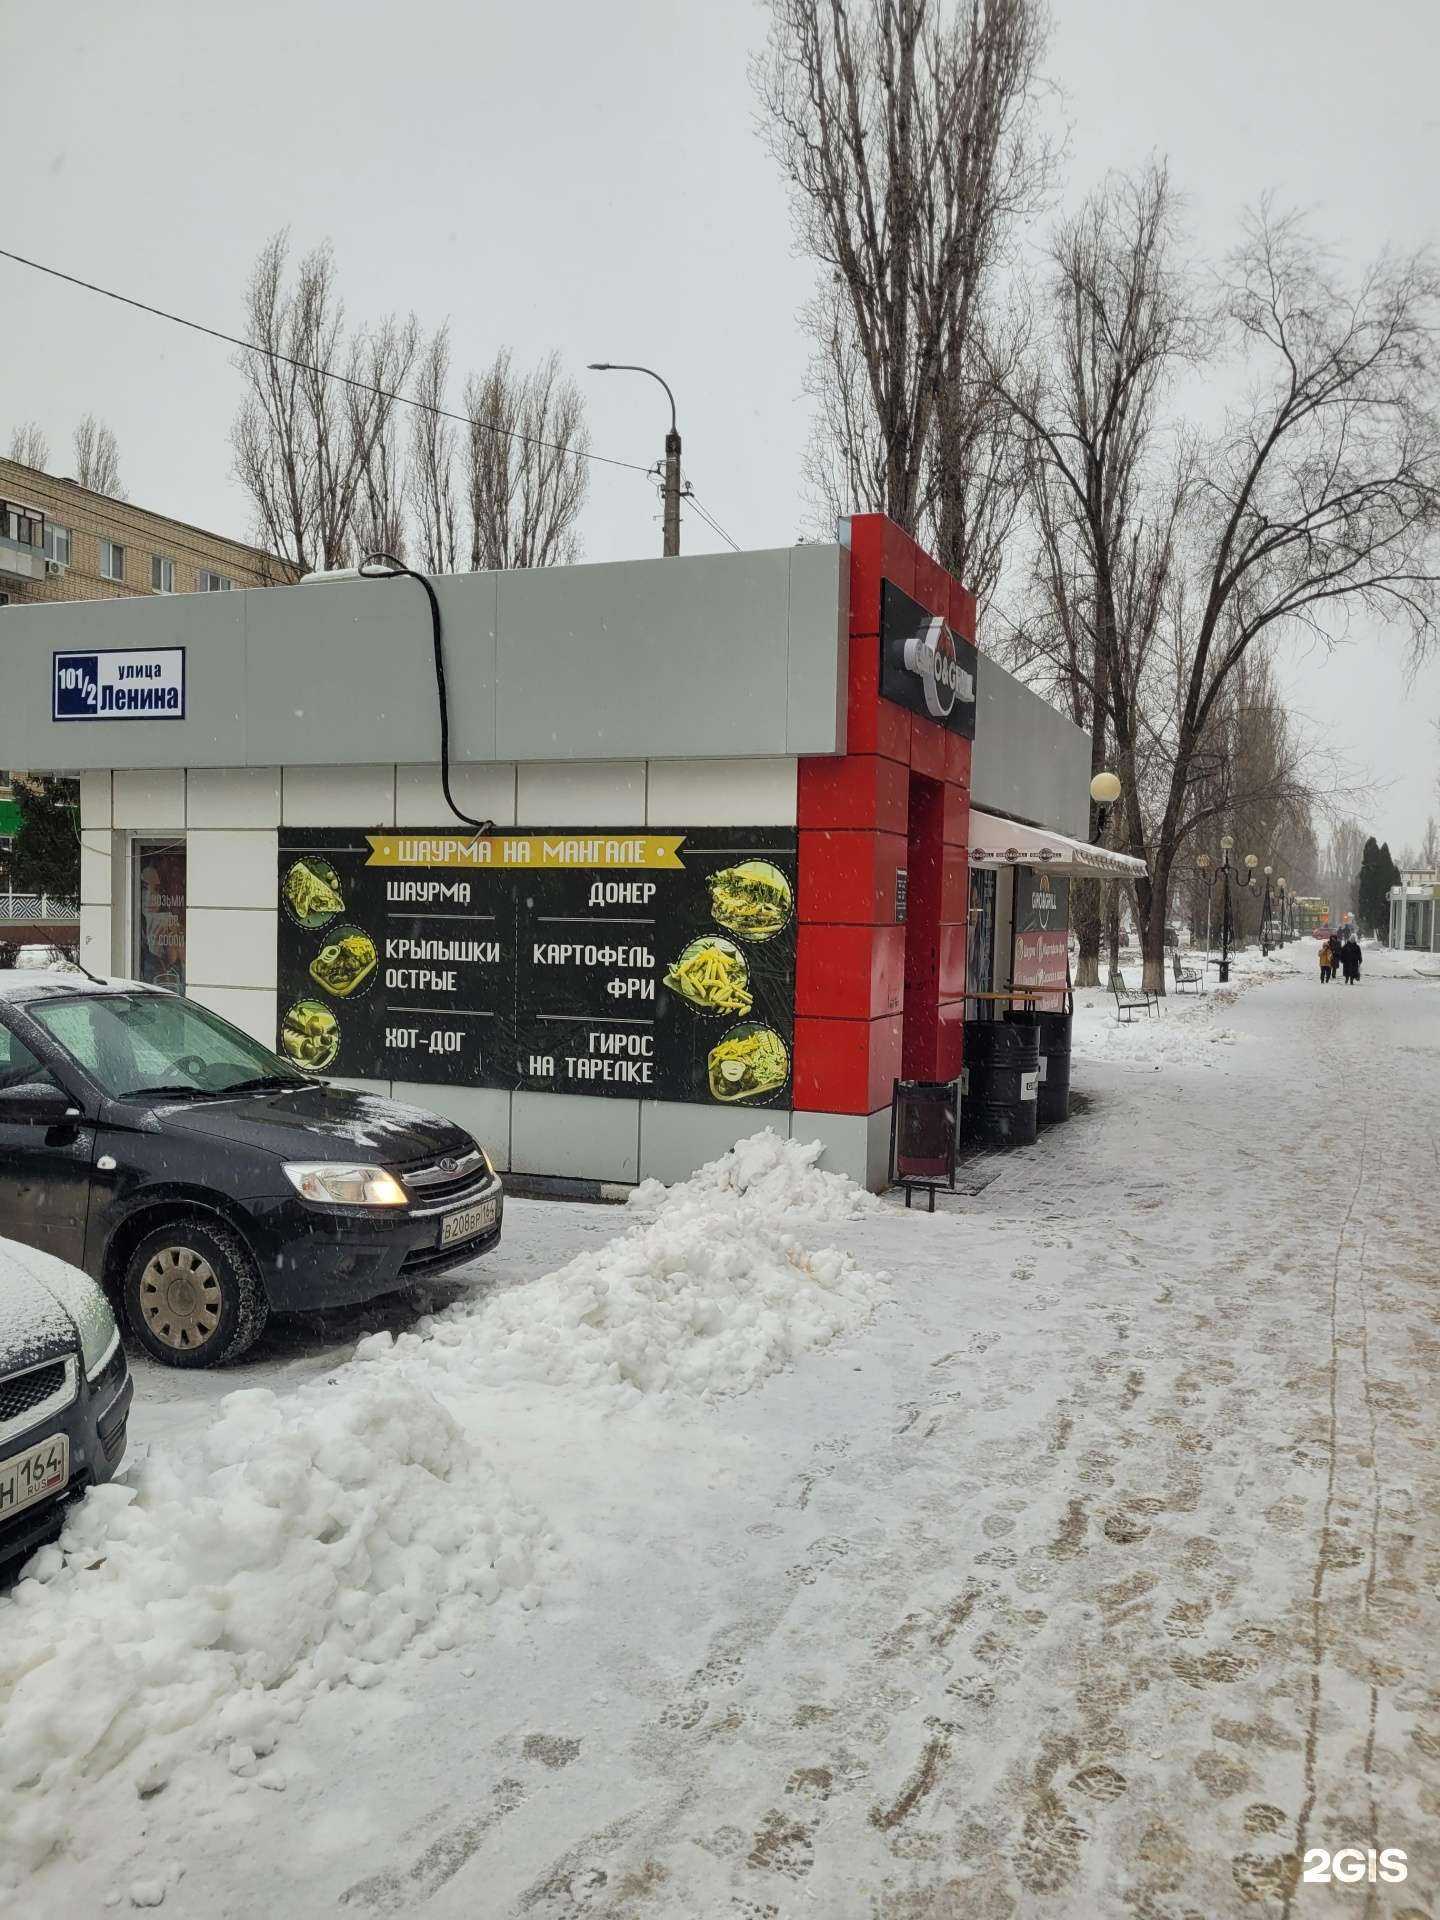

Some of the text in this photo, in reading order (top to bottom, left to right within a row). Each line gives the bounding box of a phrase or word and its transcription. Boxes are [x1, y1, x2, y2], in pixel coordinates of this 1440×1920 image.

[118, 664, 162, 680] улица
[58, 667, 97, 705] 101/2
[100, 684, 179, 710] Ленина
[398, 840, 646, 863] ШАУРМА НА МАНГАЛЕ
[386, 881, 471, 903] ШАУРМА
[588, 882, 656, 906] ДОНЕР
[385, 939, 500, 963] КРЫЛЫШКИ
[533, 943, 656, 968] КАРТОФЕЛЬ
[385, 968, 457, 991] ОСТРЫЕ
[606, 978, 655, 1000] ФРИ
[385, 1028, 466, 1054] ХОТ-ДОГ
[589, 1032, 654, 1056] ГИРОС
[529, 1055, 654, 1083] НА ТАРЕЛКЕ
[21, 1446, 56, 1486] 164
[28, 1479, 48, 1496] RUS
